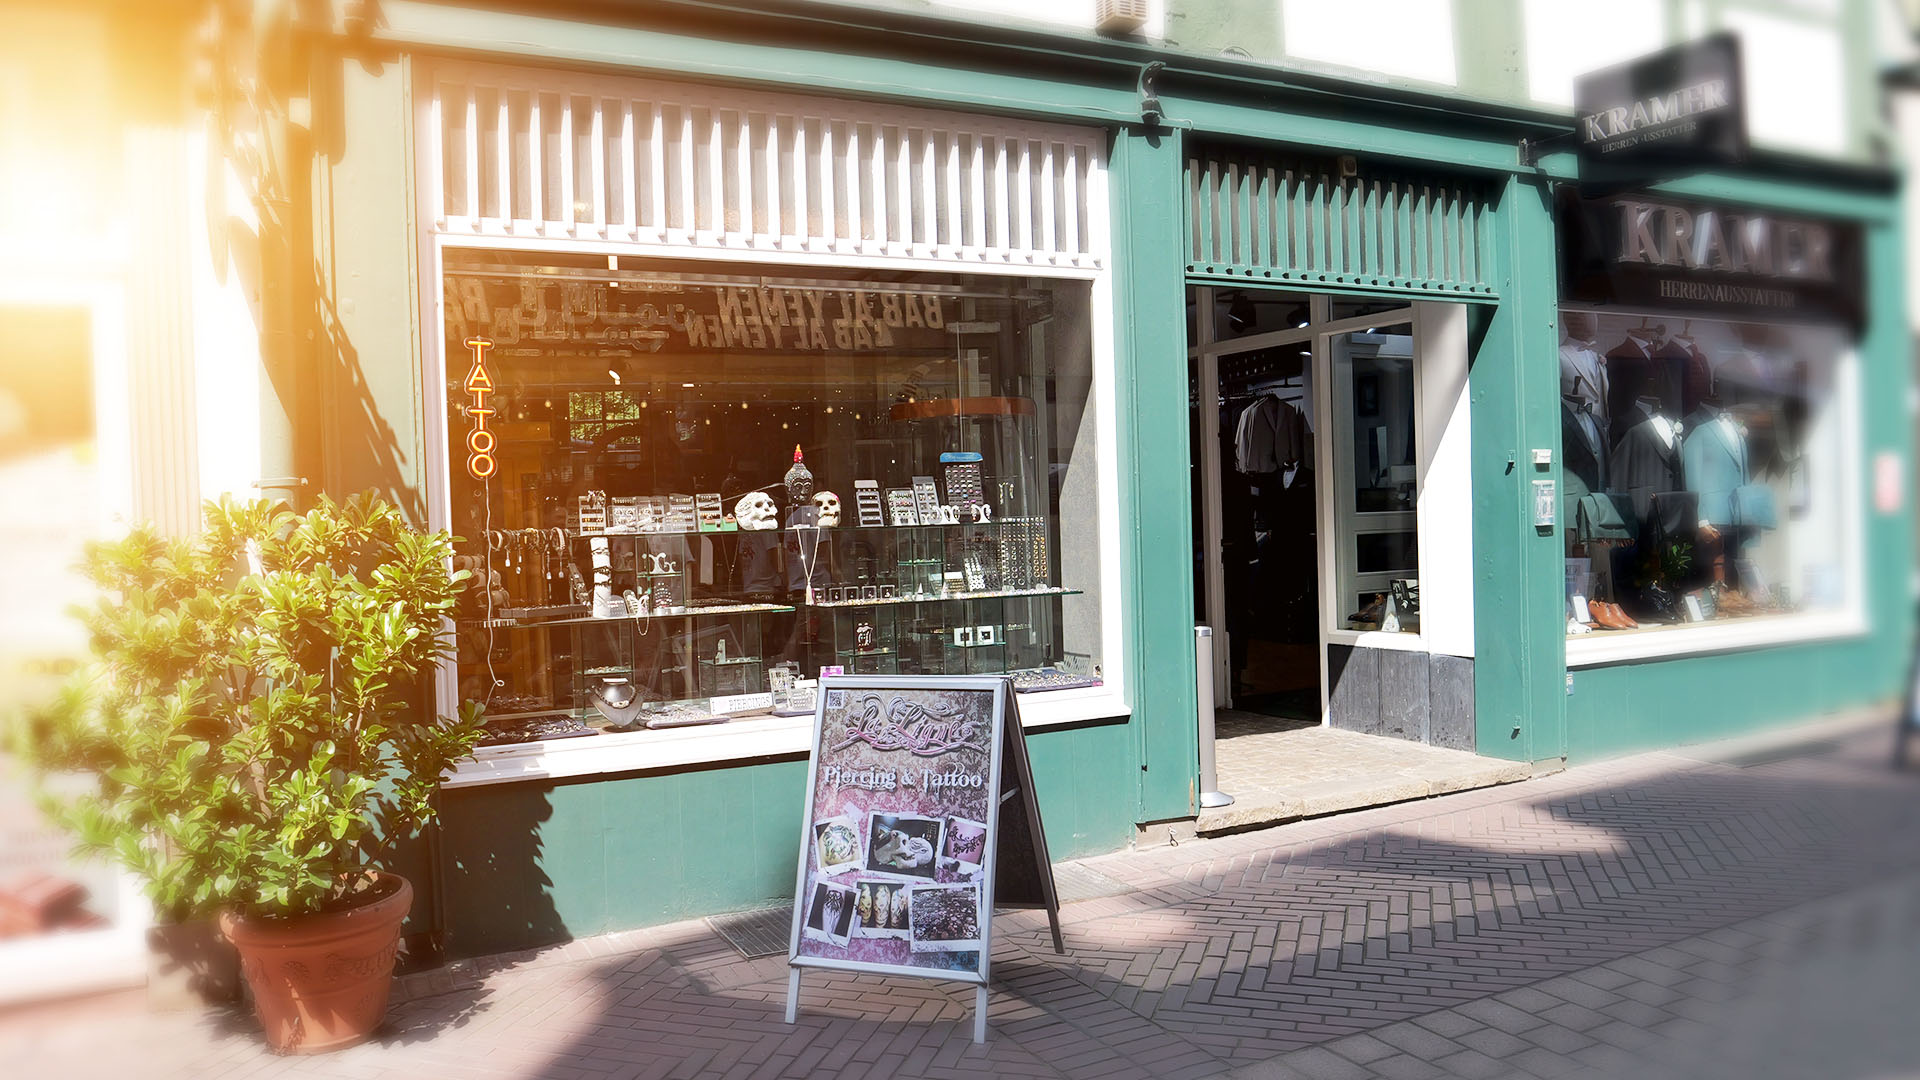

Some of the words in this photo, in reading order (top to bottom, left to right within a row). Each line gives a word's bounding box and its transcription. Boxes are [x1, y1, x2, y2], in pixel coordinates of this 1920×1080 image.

[1583, 79, 1728, 144] KRAMER
[1614, 200, 1832, 280] KRAMER
[468, 340, 494, 477] TATTOO
[823, 765, 896, 790] Piercing
[901, 768, 915, 786] &
[918, 761, 983, 793] Tattoo
